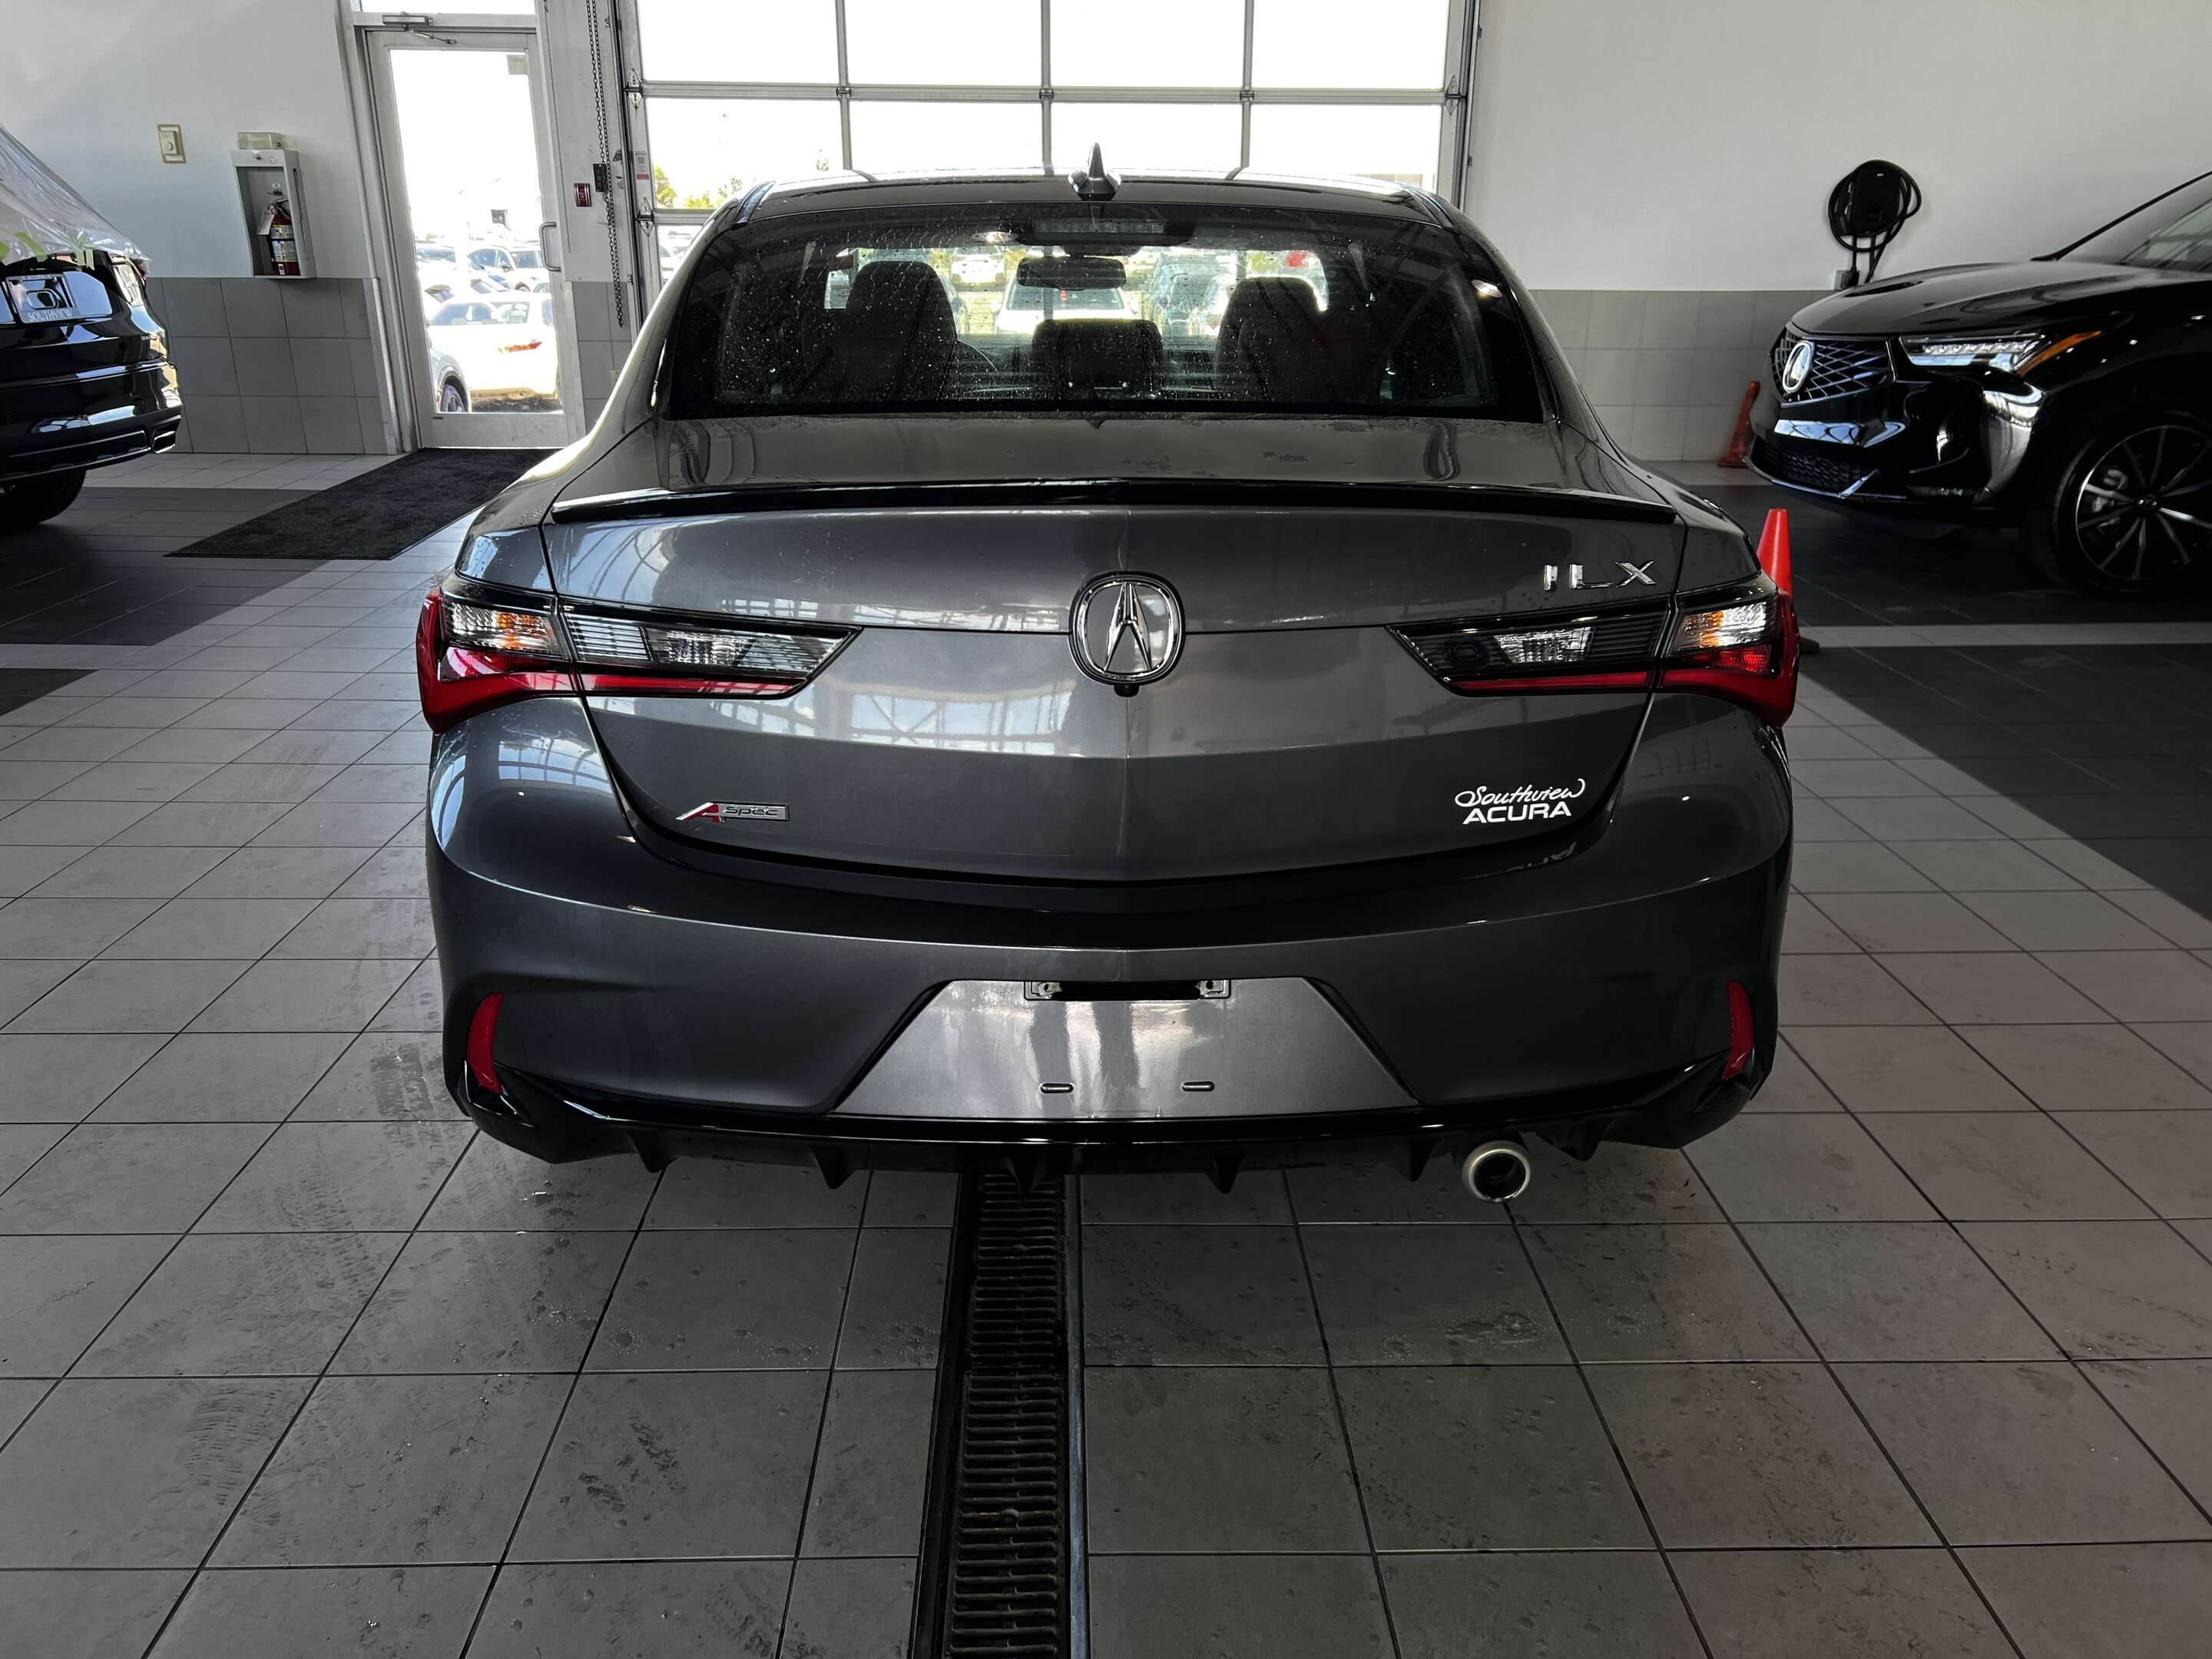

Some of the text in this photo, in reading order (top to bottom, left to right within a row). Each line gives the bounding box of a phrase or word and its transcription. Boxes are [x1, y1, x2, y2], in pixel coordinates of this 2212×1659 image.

[1543, 560, 1657, 591] ILX
[1455, 778, 1585, 807] Southview
[1462, 801, 1571, 824] ACURA
